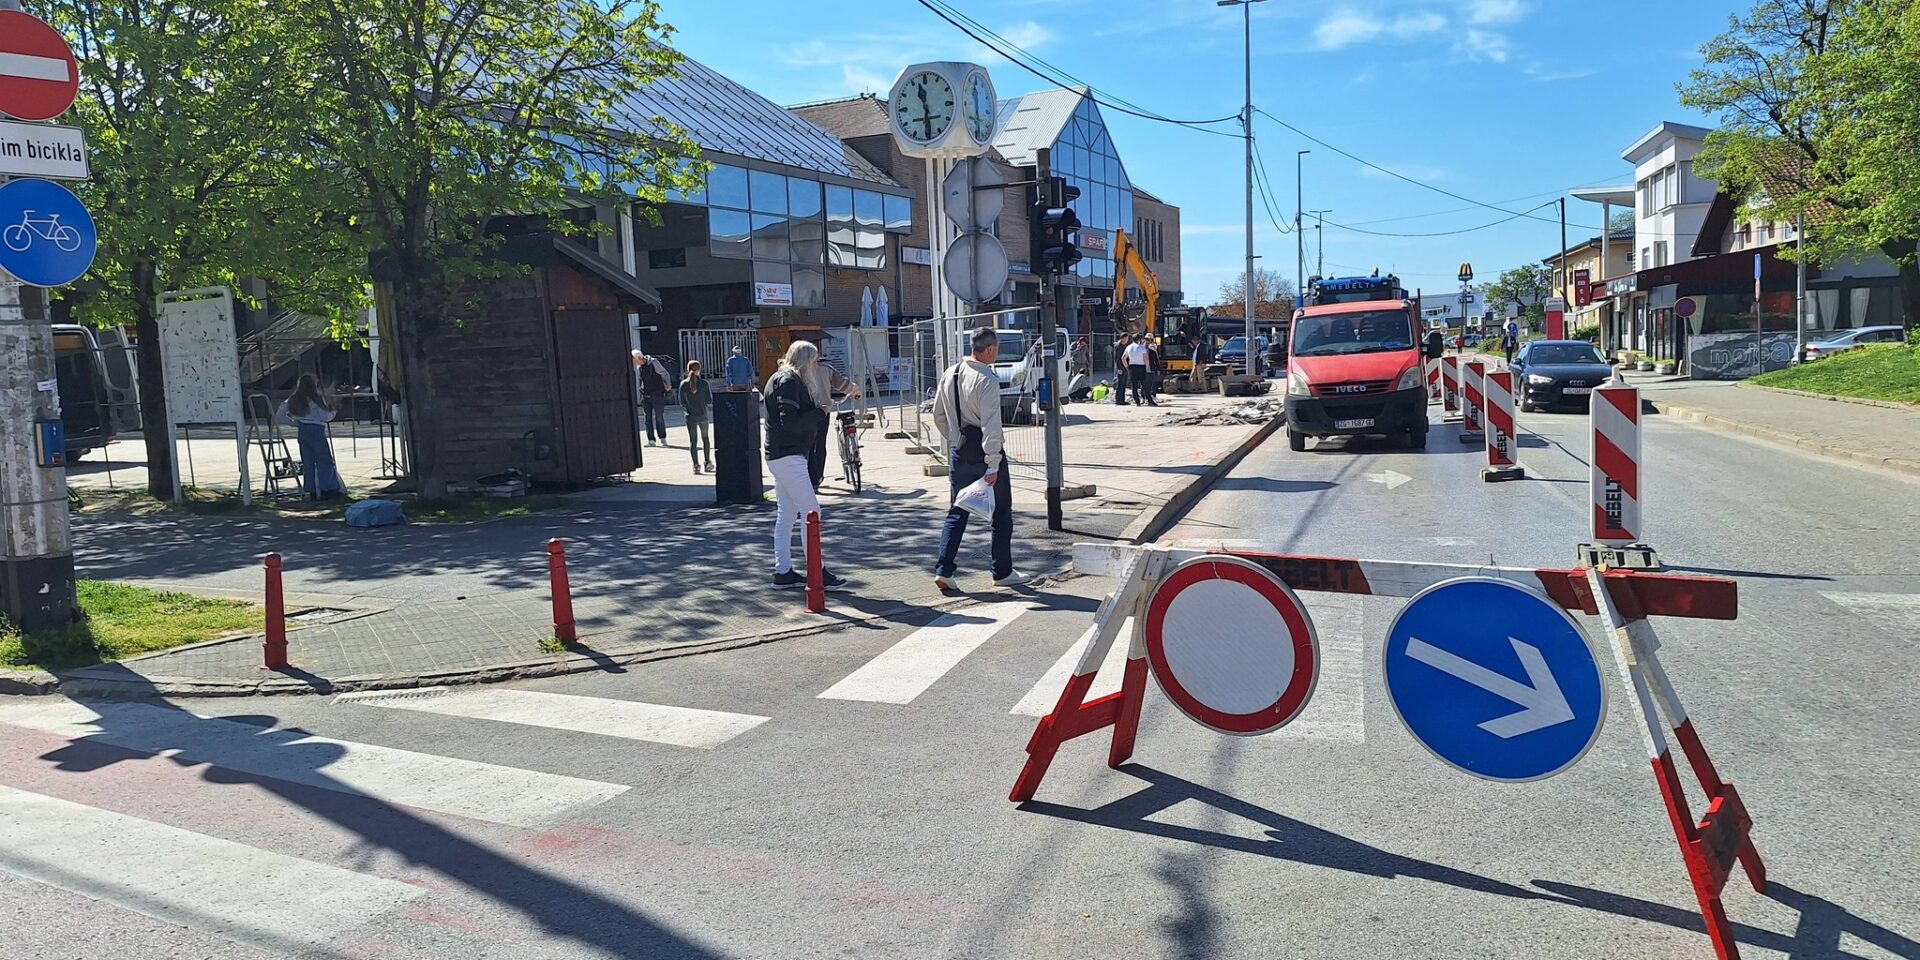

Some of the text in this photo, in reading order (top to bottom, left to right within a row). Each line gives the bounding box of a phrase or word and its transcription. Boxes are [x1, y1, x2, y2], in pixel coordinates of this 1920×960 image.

[1, 138, 82, 162] im bicikla
[1087, 237, 1104, 248] SPAR
[1331, 282, 1370, 290] MEBELT
[1606, 477, 1621, 529] MEBELT
[1262, 559, 1353, 590] EBELT
